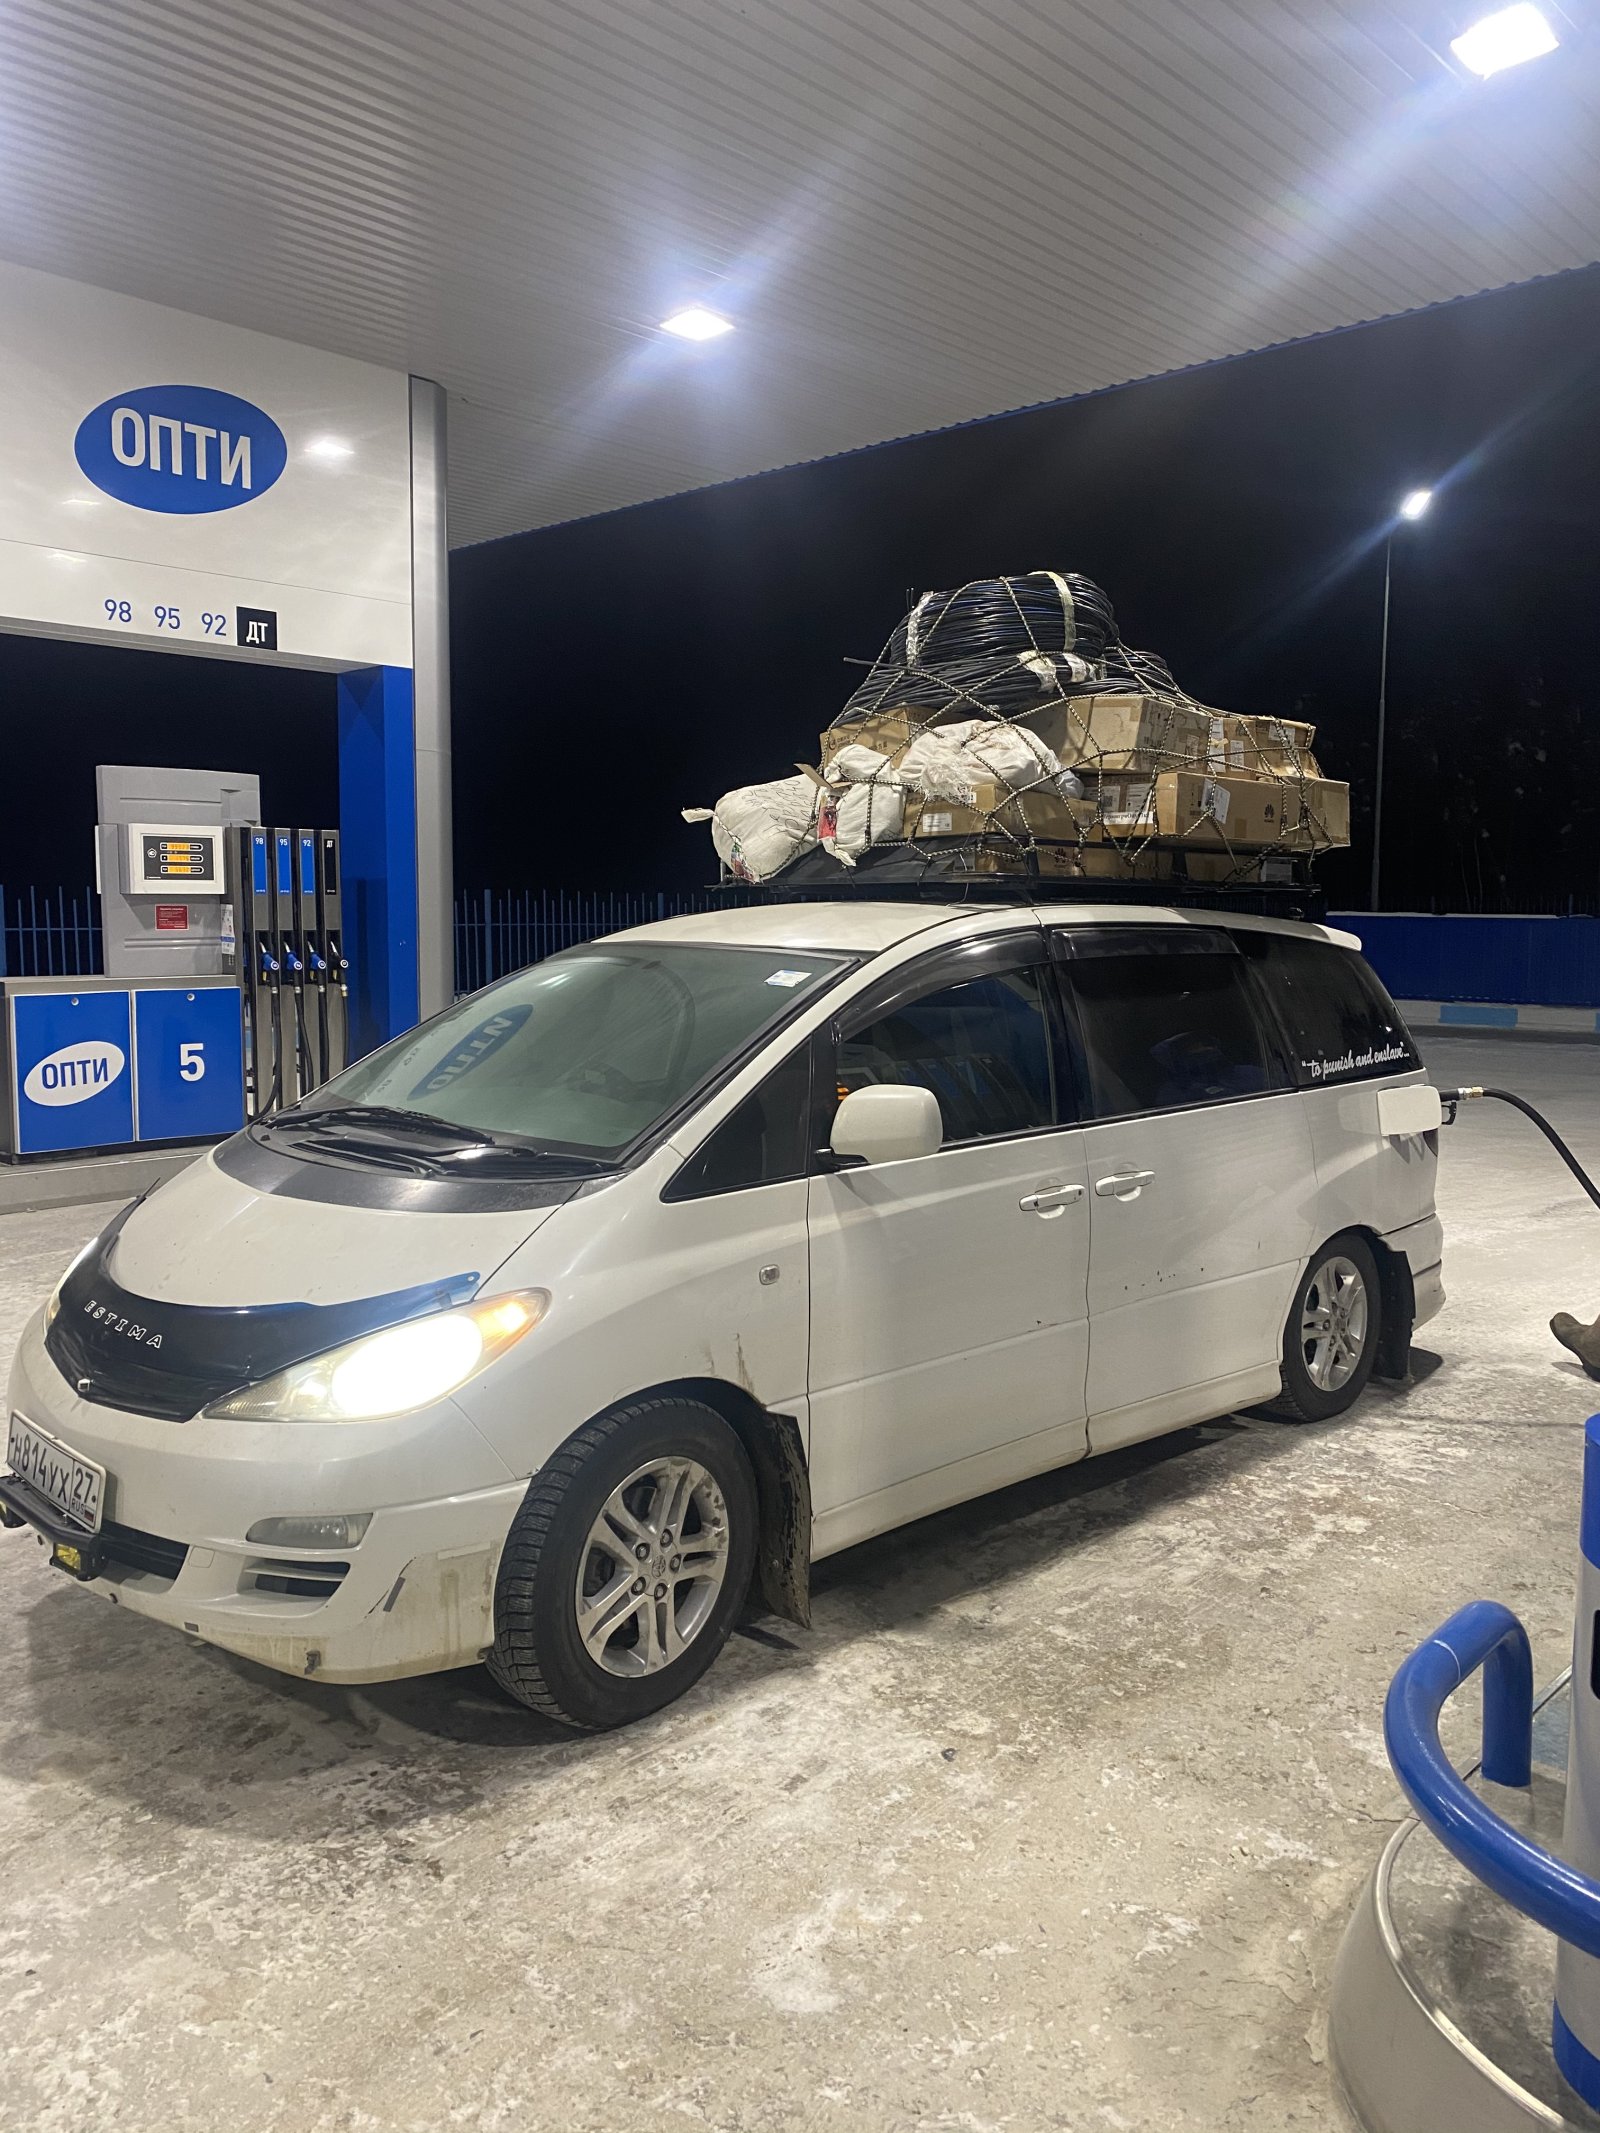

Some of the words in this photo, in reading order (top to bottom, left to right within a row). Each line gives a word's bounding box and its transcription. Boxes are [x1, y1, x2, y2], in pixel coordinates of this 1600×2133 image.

[110, 407, 252, 490] ОПТИ
[104, 598, 133, 624] 98
[153, 604, 182, 630] 95
[200, 612, 228, 637] 92
[245, 620, 269, 644] ДТ
[255, 837, 264, 845] 98
[280, 838, 288, 846] 95
[303, 839, 311, 847] 92
[41, 1057, 109, 1090] ОПТИ
[179, 1043, 205, 1082] 5
[1322, 1049, 1355, 1080] punish
[1355, 1046, 1374, 1067] and
[84, 1300, 164, 1349] ESTIMA
[73, 1467, 94, 1504] 27
[71, 1497, 85, 1515] RUS
